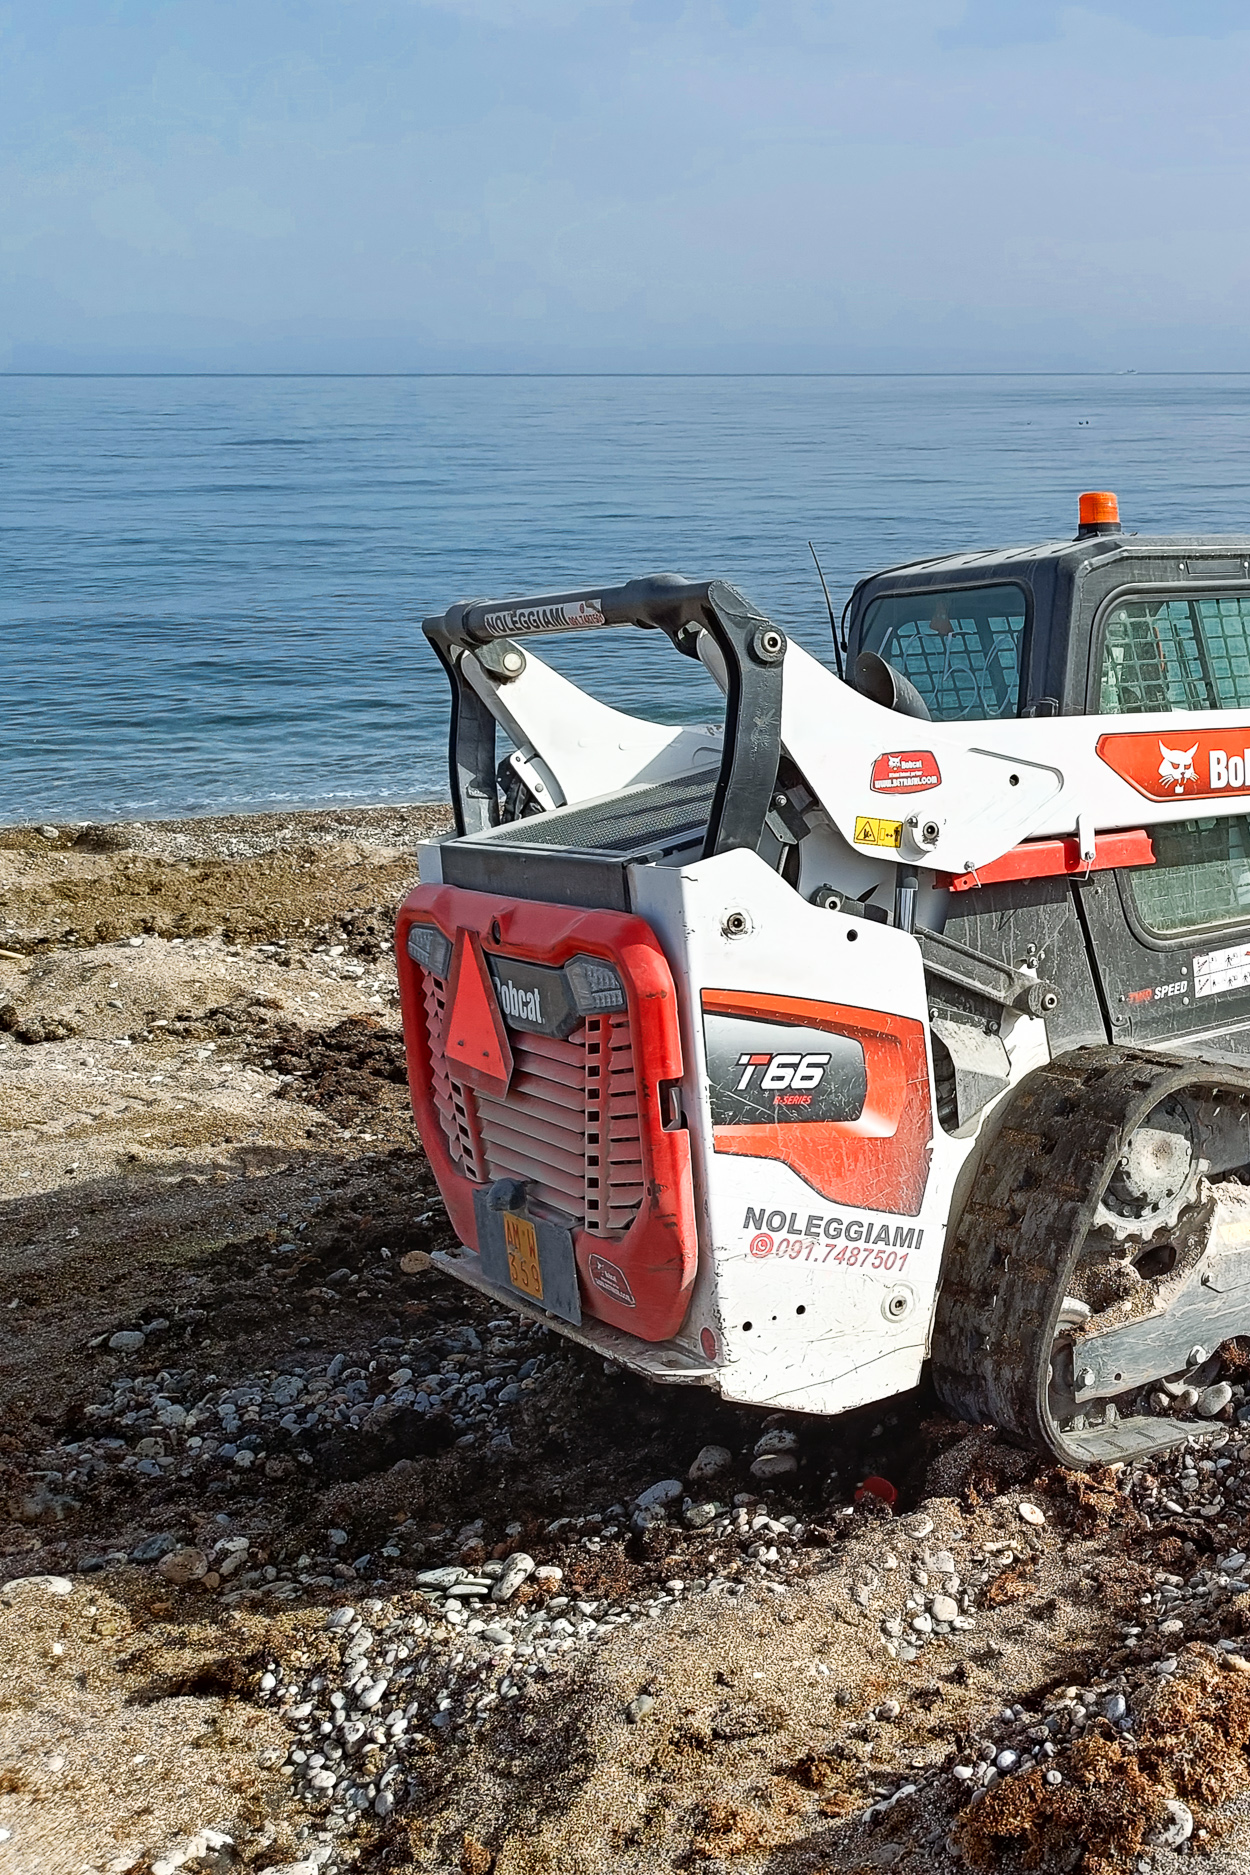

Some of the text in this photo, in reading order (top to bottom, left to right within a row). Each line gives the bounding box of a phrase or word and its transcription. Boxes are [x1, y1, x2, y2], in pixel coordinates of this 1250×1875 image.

[486, 607, 570, 634] NOLEGGIAMI
[901, 760, 922, 769] Bobcat
[1154, 981, 1188, 1000] SPEED
[735, 1053, 832, 1091] T66
[773, 1095, 812, 1105] R-SERIES
[743, 1207, 924, 1249] NOLEGGIAMI
[775, 1238, 909, 1272] 091.7487501
